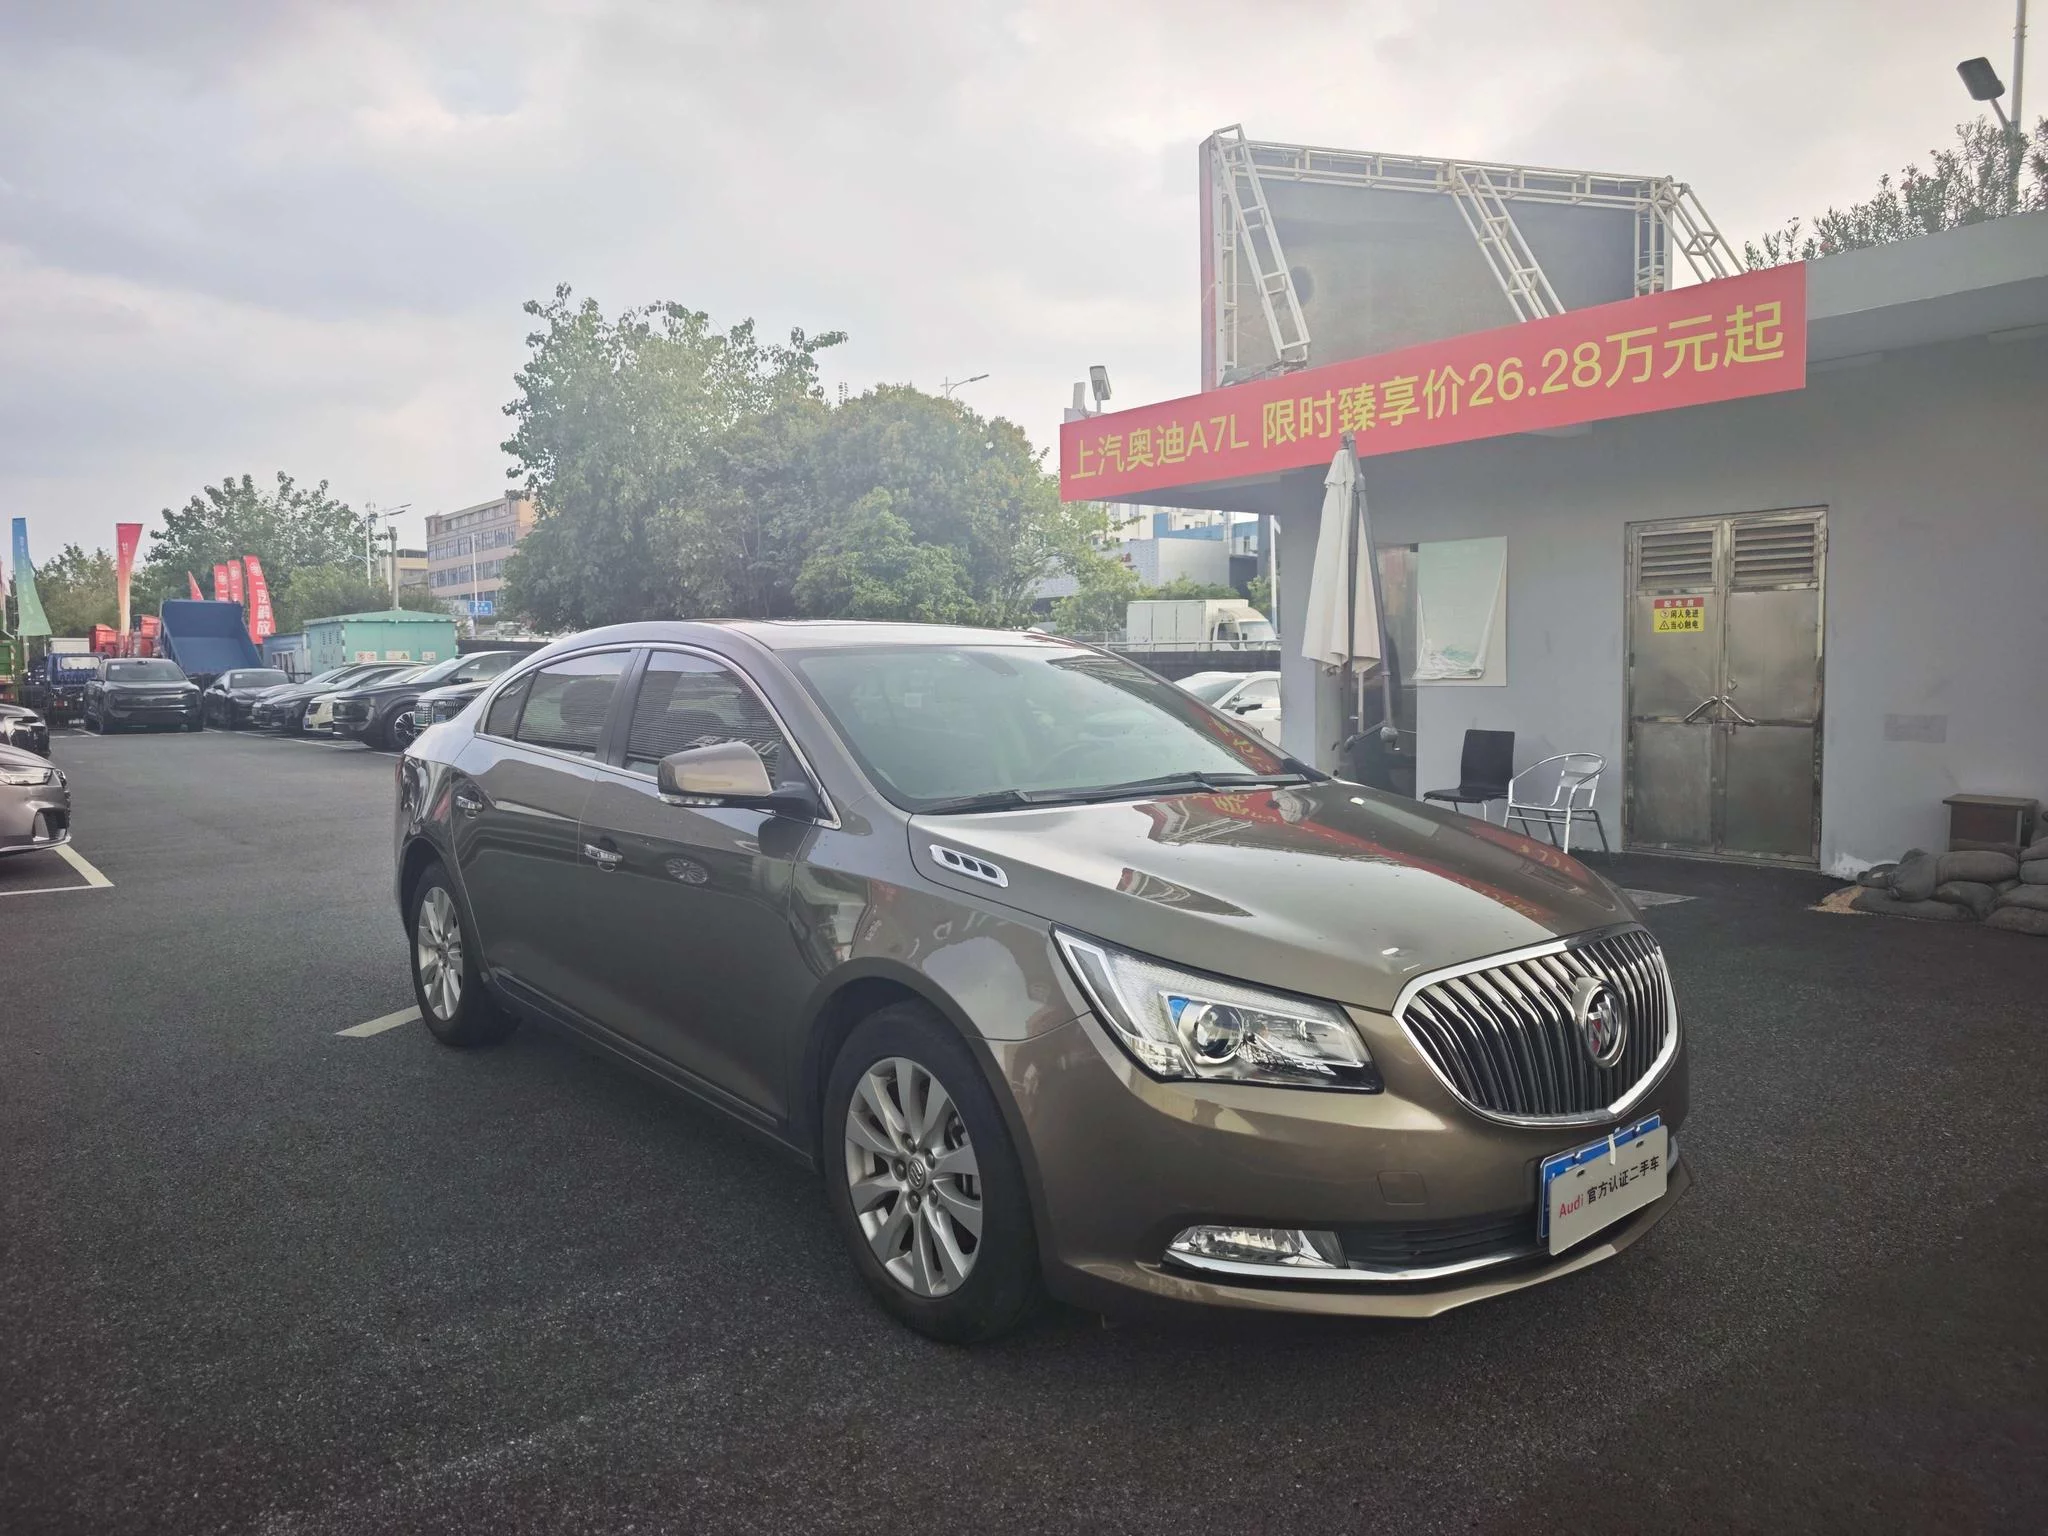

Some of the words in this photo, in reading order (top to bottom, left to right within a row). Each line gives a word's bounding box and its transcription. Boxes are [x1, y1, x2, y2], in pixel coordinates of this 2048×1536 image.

[1069, 413, 1249, 480] 上汽奥迪A7L
[1262, 301, 1785, 449] 限时臻享价26.28万元起
[256, 582, 271, 634] 一汽解放
[1670, 609, 1699, 618] 闲人免进
[1670, 620, 1699, 629] 当心触电
[1558, 1193, 1584, 1218] Audi
[1587, 1156, 1659, 1204] 官方认证二手车
